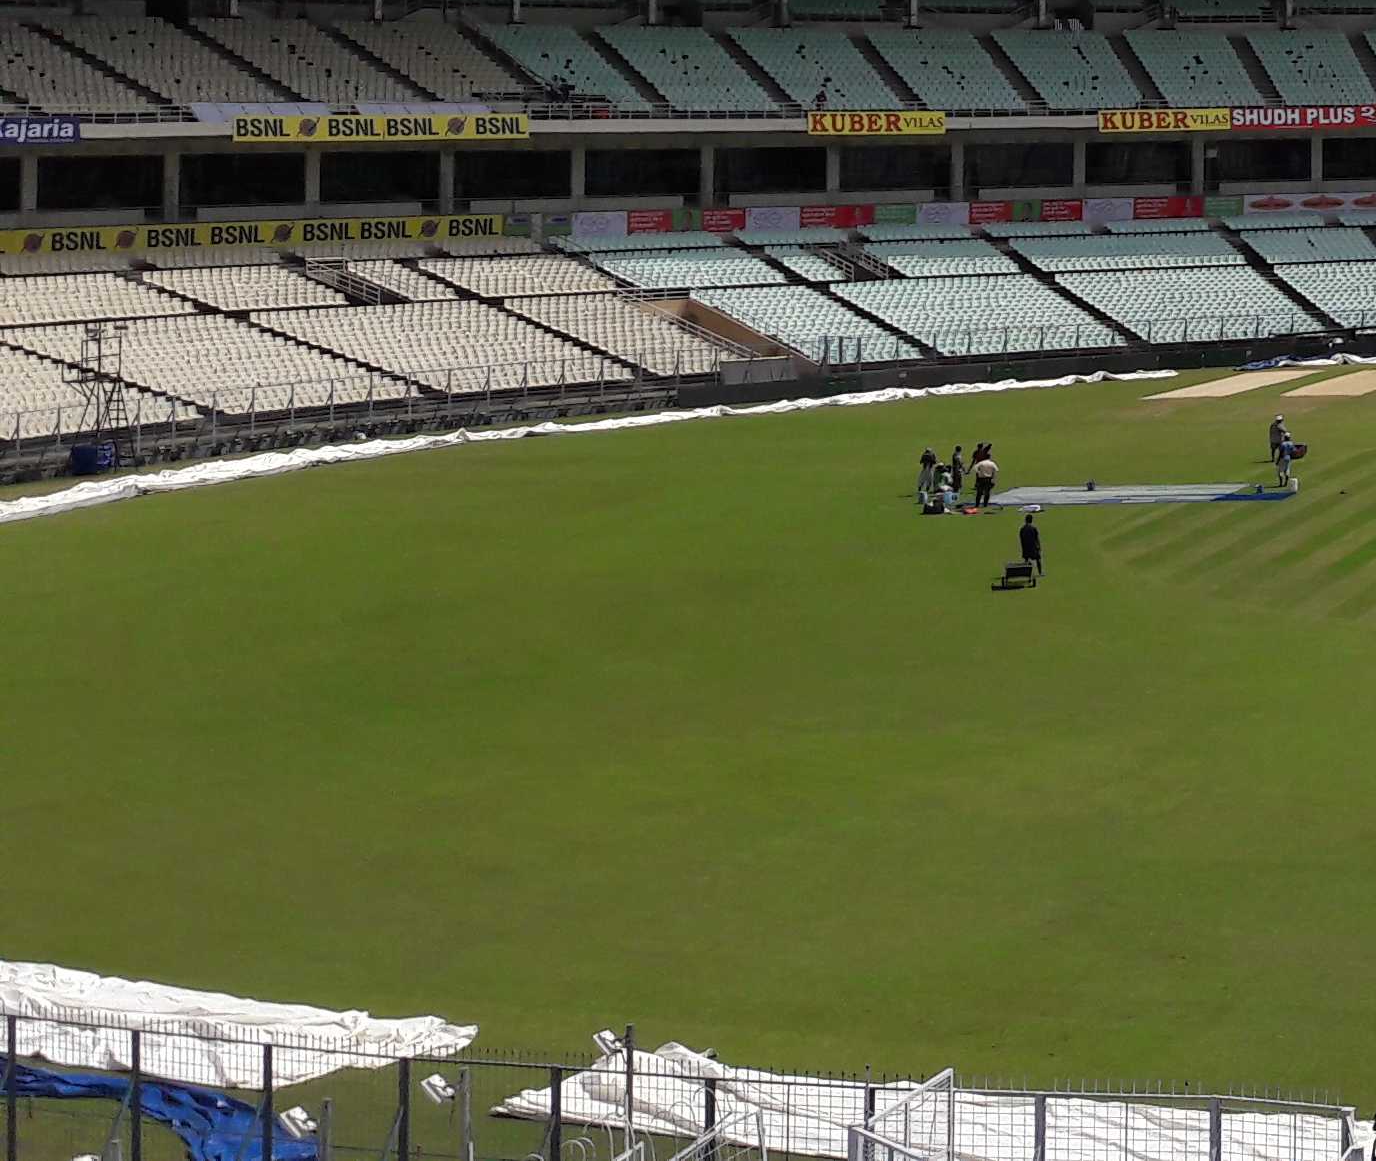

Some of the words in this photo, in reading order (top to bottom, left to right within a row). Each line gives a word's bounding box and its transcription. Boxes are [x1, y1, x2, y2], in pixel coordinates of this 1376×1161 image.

[810, 114, 902, 132] KUBER
[903, 117, 943, 128] VILAS
[1100, 112, 1190, 130] KUBER
[1190, 114, 1228, 126] VILAS
[1232, 107, 1300, 125] SHUDH
[1306, 106, 1355, 124] PLUS
[236, 118, 290, 137] BSNL
[328, 118, 381, 137] BSNL
[386, 118, 439, 136] BSNL
[475, 117, 526, 135] BSNL
[51, 231, 106, 251] BSNL
[147, 228, 201, 247] BSNL
[210, 225, 265, 245] BSNL
[303, 222, 355, 241] BSNL
[360, 220, 412, 239] BSNL
[448, 219, 499, 237] BSNL
